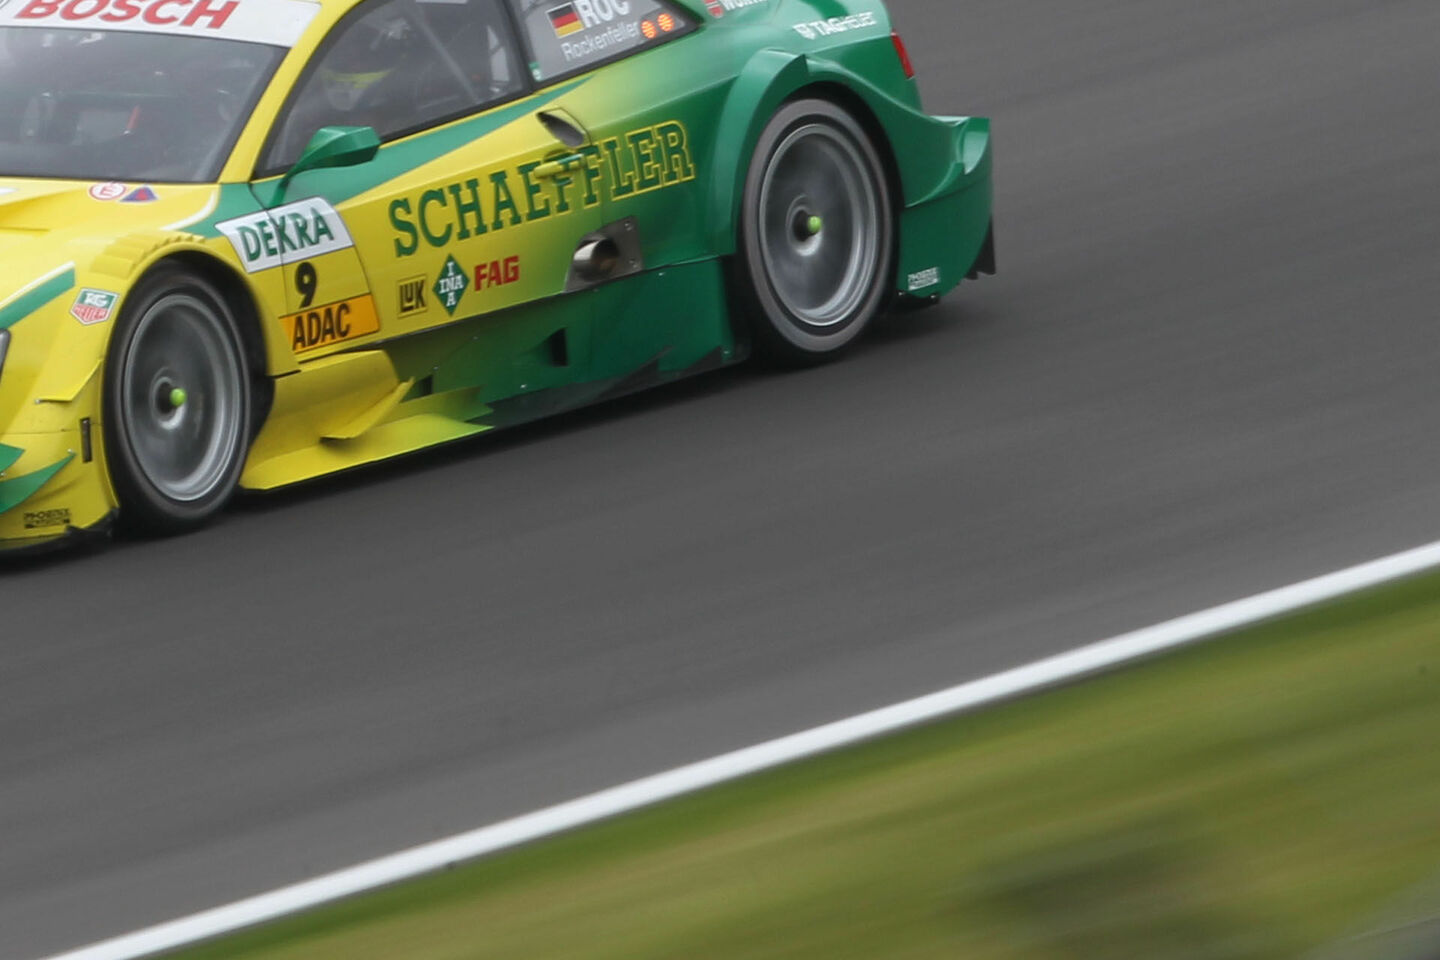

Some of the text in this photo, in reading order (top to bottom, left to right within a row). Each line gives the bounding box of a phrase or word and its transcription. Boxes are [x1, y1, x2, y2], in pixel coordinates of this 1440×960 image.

[561, 22, 640, 61] Rockenfeller
[389, 120, 696, 258] SCHAEFFLER
[237, 208, 334, 262] DEKRA
[295, 262, 318, 308] 9
[474, 256, 519, 291] FAG
[292, 303, 351, 352] ADAC
